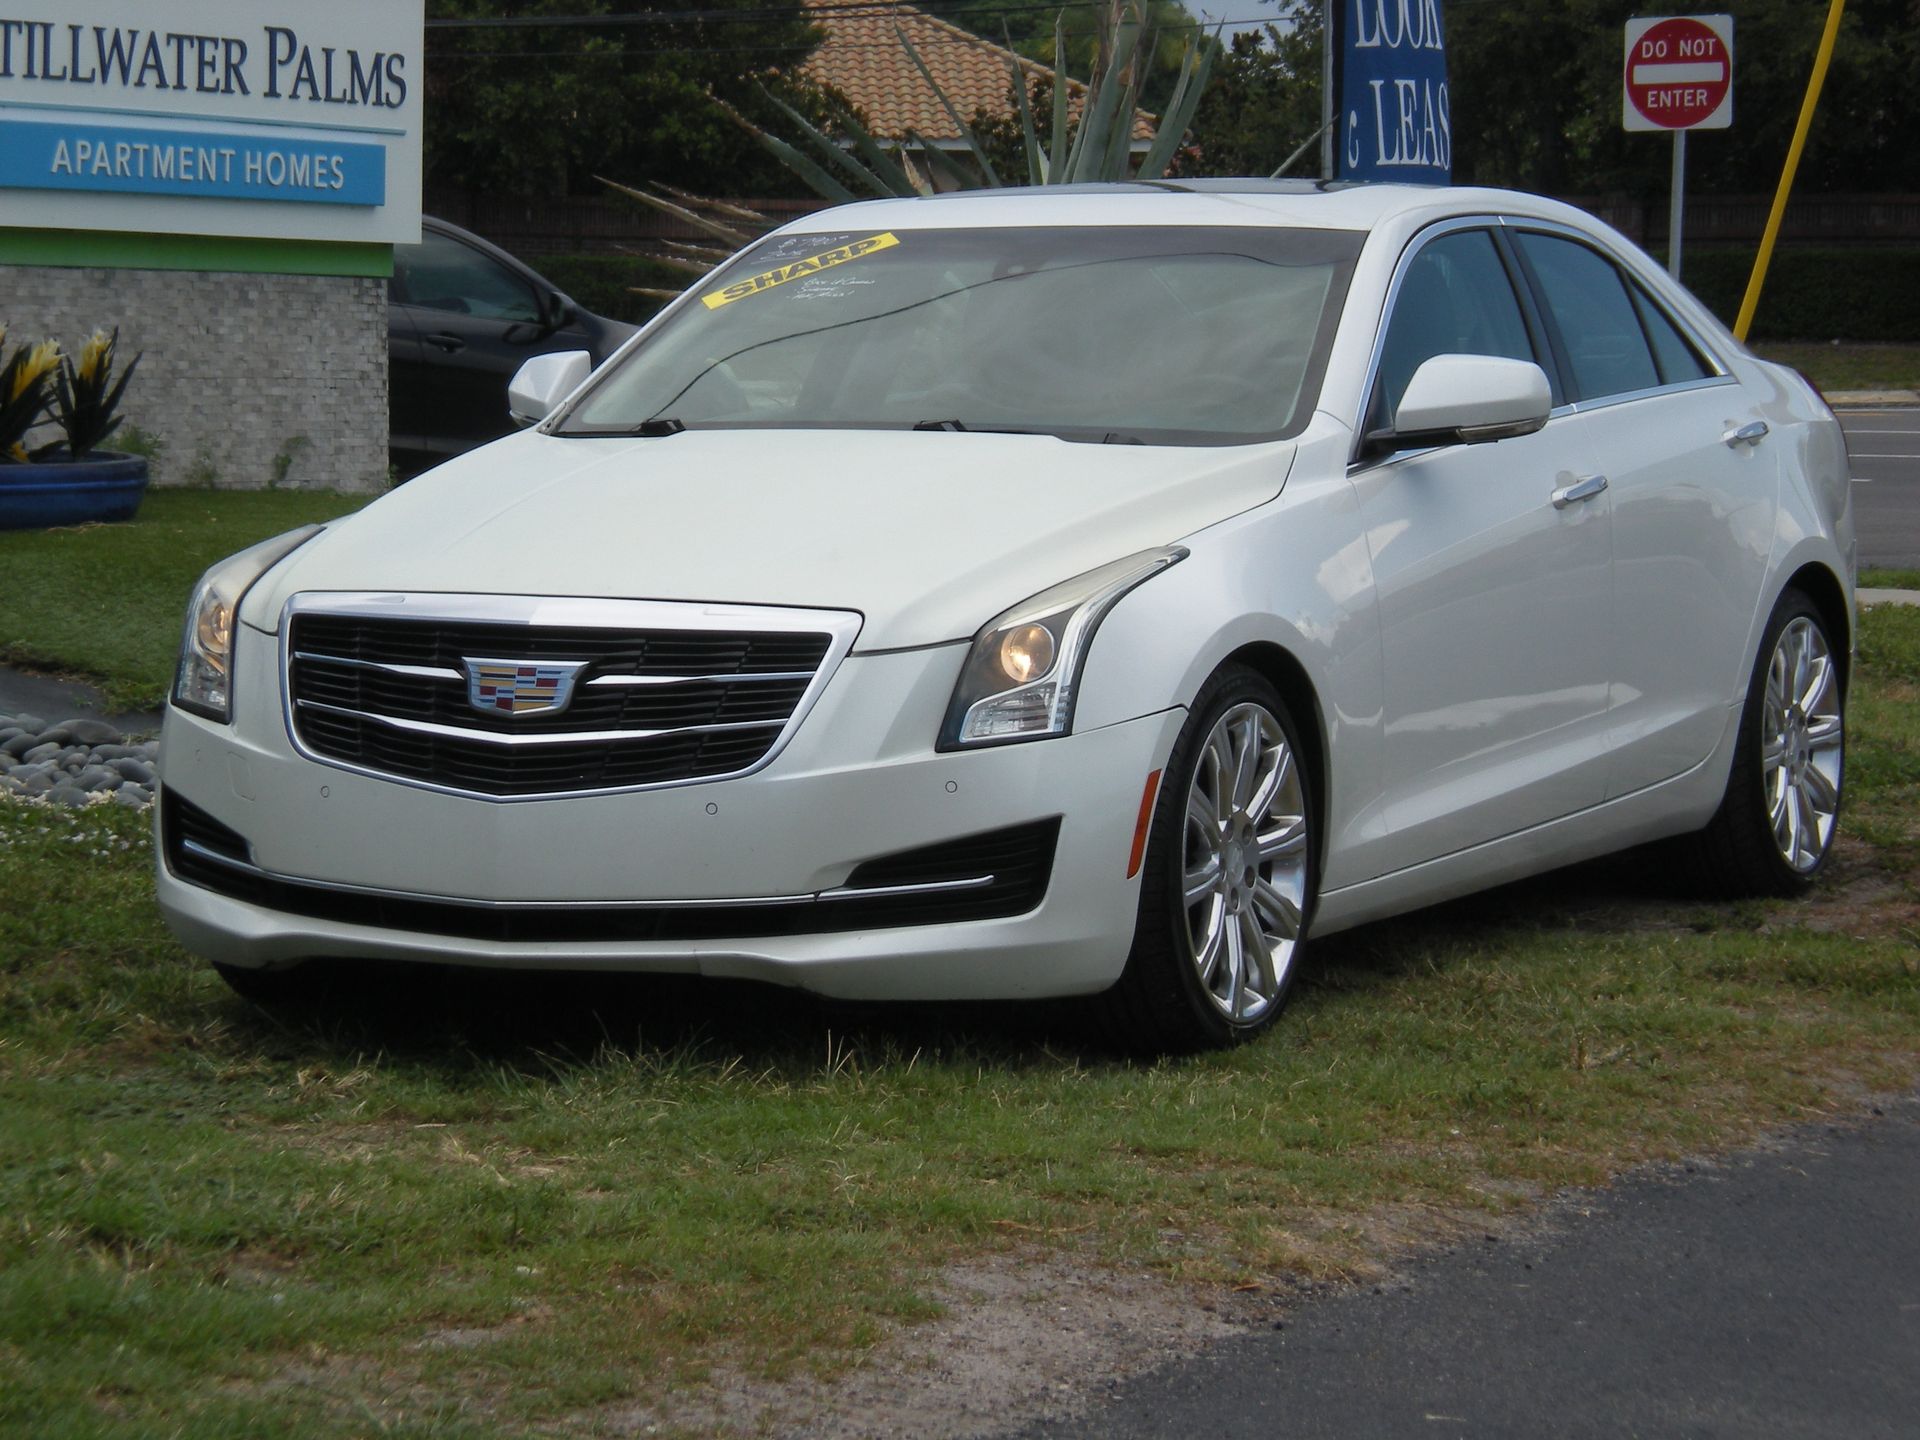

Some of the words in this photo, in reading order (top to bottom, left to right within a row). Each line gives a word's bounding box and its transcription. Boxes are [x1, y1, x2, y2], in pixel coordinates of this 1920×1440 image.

[263, 26, 407, 109] PALMS
[1642, 40, 1667, 58] DO
[1680, 38, 1716, 57] NOT
[1647, 88, 1708, 108] ENTER
[50, 138, 236, 183] APARTMENT
[244, 150, 345, 190] HOMES
[722, 238, 882, 301] SHARP
